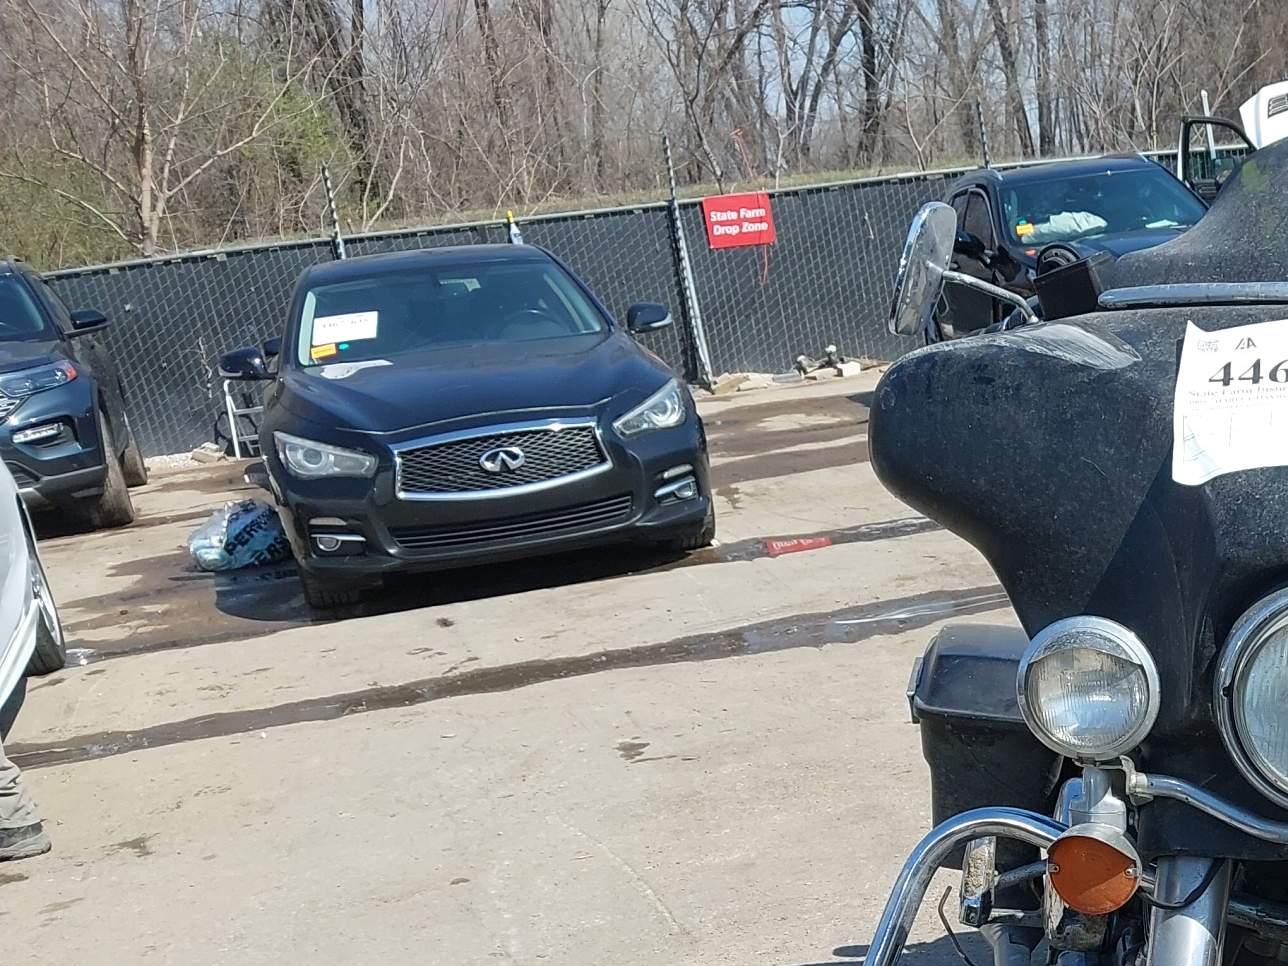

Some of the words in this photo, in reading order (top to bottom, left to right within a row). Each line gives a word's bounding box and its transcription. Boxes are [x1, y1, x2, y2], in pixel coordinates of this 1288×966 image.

[710, 210, 738, 222] State
[740, 207, 766, 219] Farm
[713, 223, 740, 236] Drop
[741, 221, 769, 233] Zone
